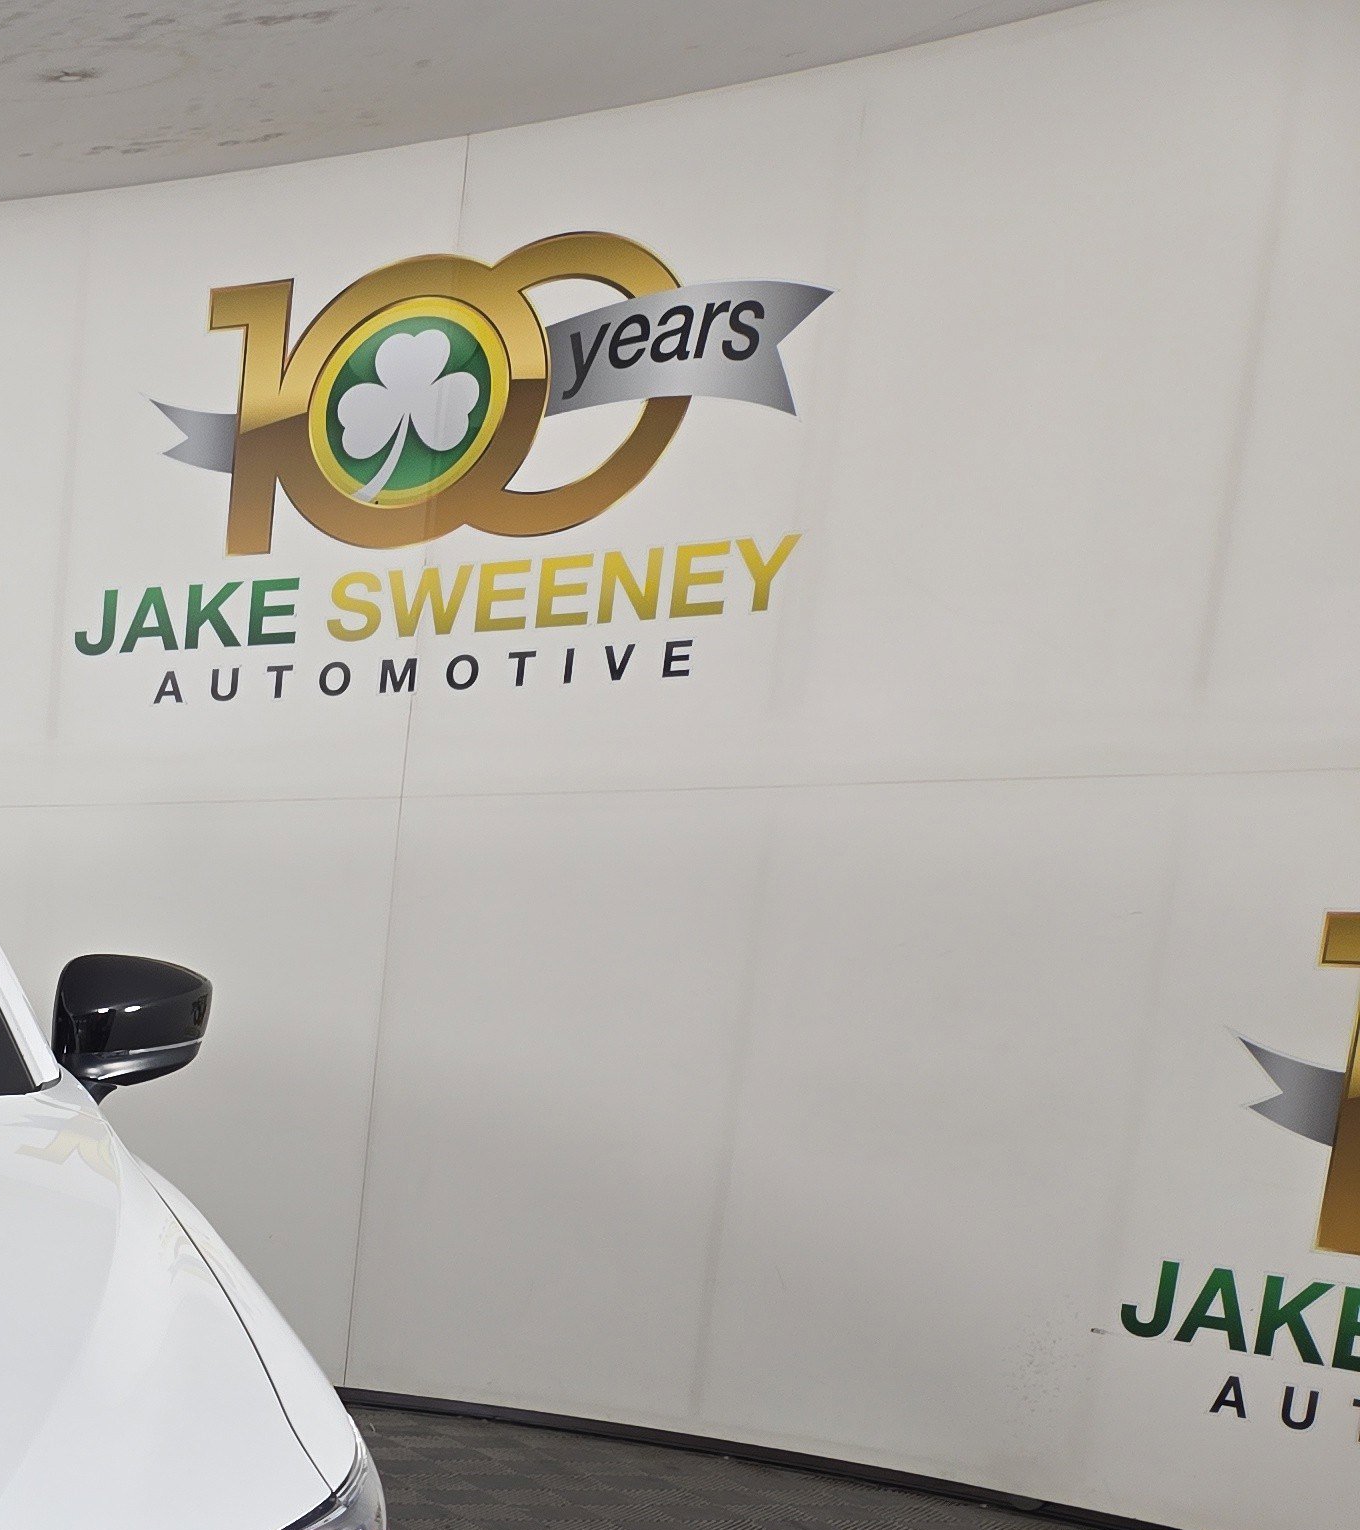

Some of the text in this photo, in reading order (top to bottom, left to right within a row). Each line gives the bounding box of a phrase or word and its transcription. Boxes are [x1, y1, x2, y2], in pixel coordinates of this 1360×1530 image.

[209, 230, 765, 557] 100 years
[74, 533, 803, 657] JAKE SWEENEY
[154, 640, 694, 706] AUTOMOTIVE
